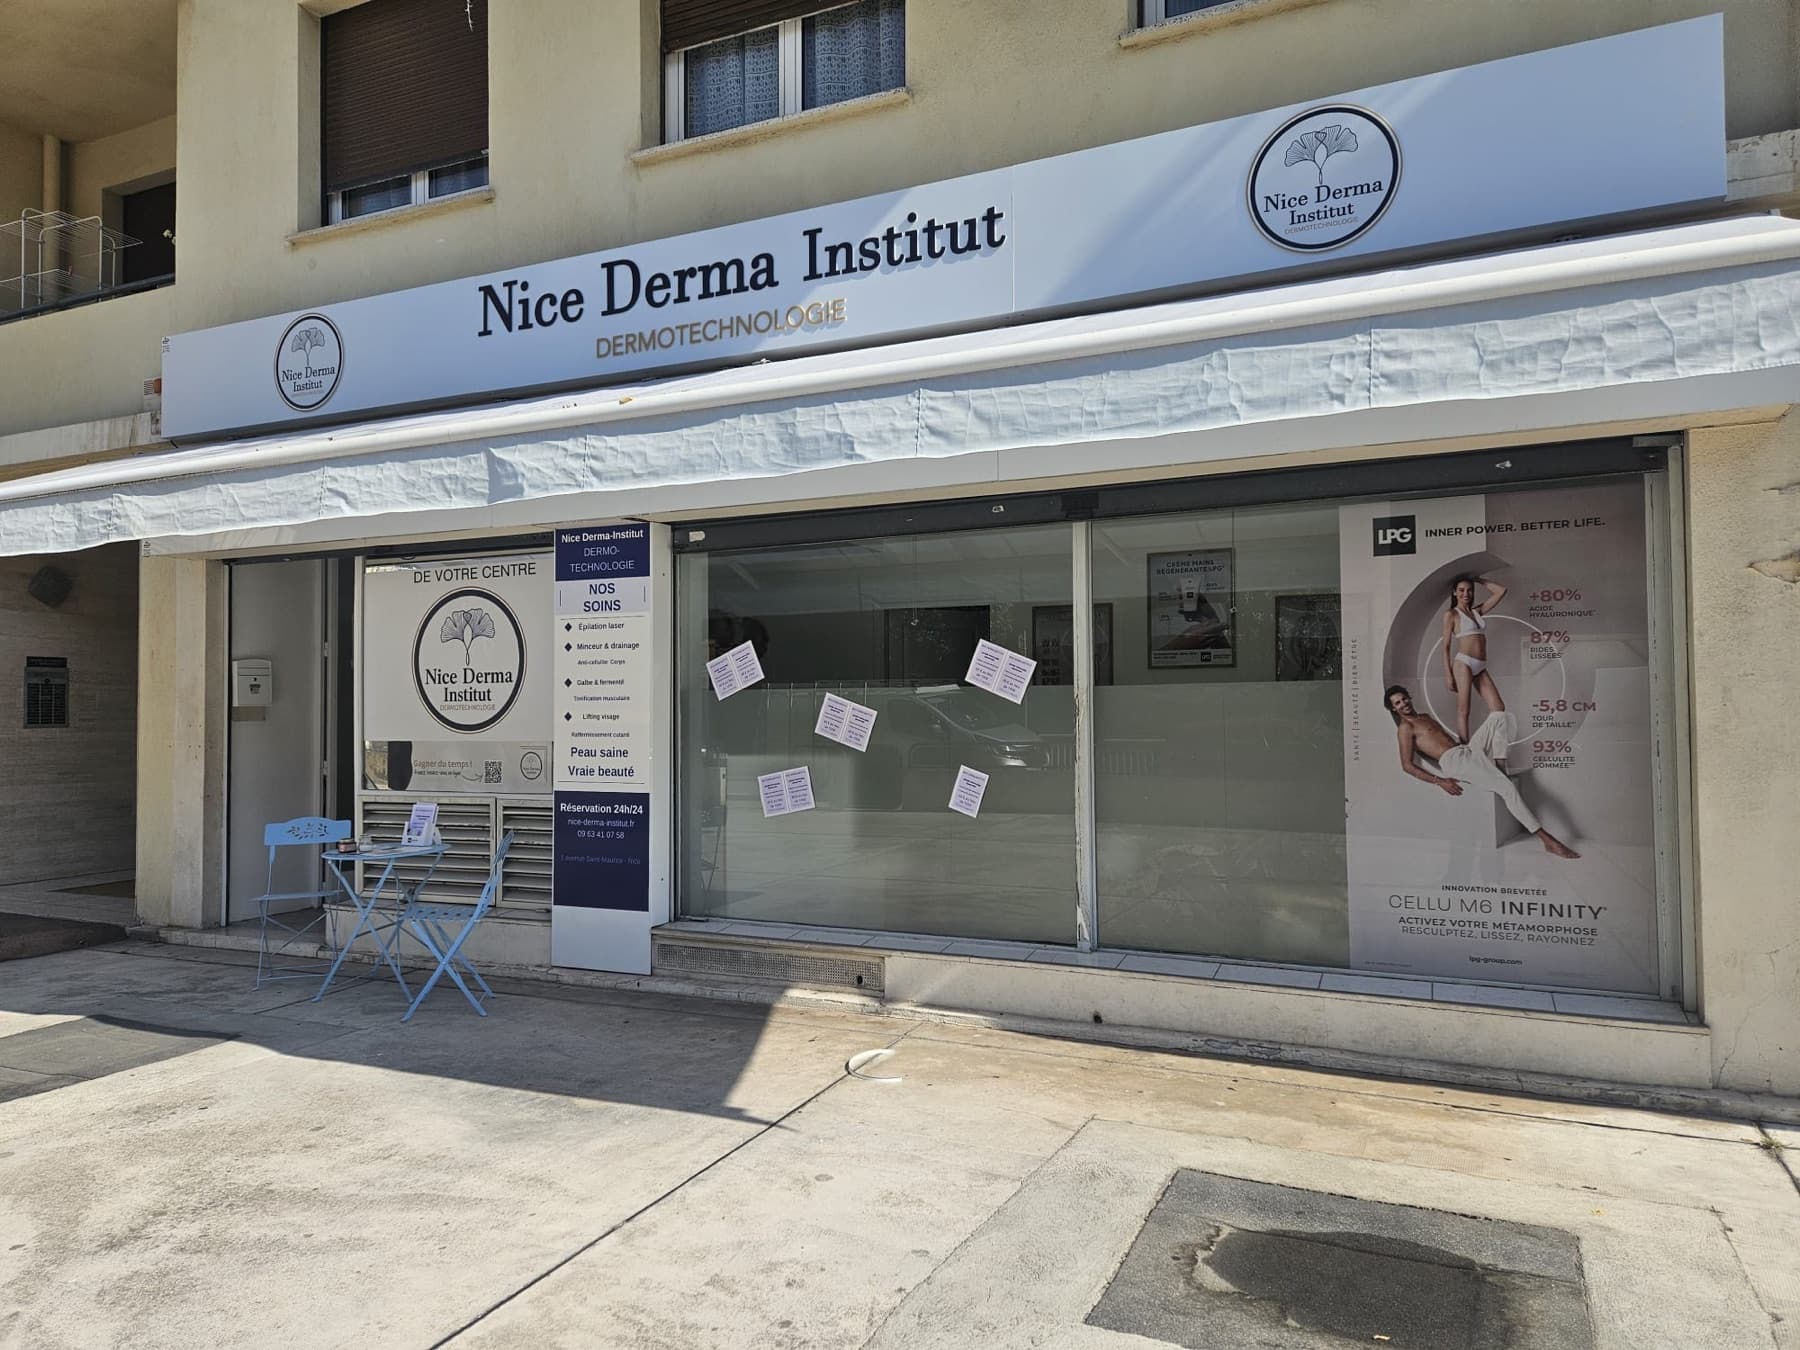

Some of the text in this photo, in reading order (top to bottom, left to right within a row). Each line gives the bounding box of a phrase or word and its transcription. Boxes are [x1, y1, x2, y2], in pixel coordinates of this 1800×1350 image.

[1264, 179, 1384, 213] Nice Derma
[1288, 202, 1355, 226] Institut
[477, 205, 1006, 338] Nice Derma Institut
[595, 297, 848, 360] DERMOTECHNOLOGIE
[281, 365, 336, 383] Nice Derma
[293, 379, 323, 392] Institut
[561, 529, 644, 543] Nice Derma-Institut
[1377, 517, 1606, 545] LPG INNER POWER. BETTER LIFE.
[583, 545, 620, 557] DERMO-
[413, 562, 537, 583] DE VOTRE CENTRE
[569, 560, 635, 573] TECHNOLOGIE
[589, 583, 616, 595] NOS
[1529, 588, 1582, 602] +80%
[583, 600, 621, 613] SOINS
[608, 621, 625, 630] laser
[1531, 630, 1571, 644] 87%
[576, 641, 640, 651] Minceur & drainage
[425, 667, 514, 685] Nice Derma
[443, 687, 493, 703] Institut
[1532, 699, 1597, 714] -5,8 CM
[582, 713, 620, 722] Lifting visage
[570, 746, 629, 758] Peau saine
[1533, 740, 1573, 753] 93%
[567, 765, 635, 778] Vraie beauté
[560, 803, 644, 815] Réservation 24h/24
[577, 830, 586, 838] 09
[596, 831, 605, 839] 41
[606, 831, 615, 839] 07
[1441, 884, 1498, 894] INNOVATION
[1388, 894, 1604, 920] CELLU M6 INFINITY
[1398, 915, 1599, 936] ACTIVEZ VOTRE MÉTAMORPHOSE
[1401, 925, 1477, 940] RESCULPTEZ,
[1480, 930, 1524, 943] LISSEZ,
